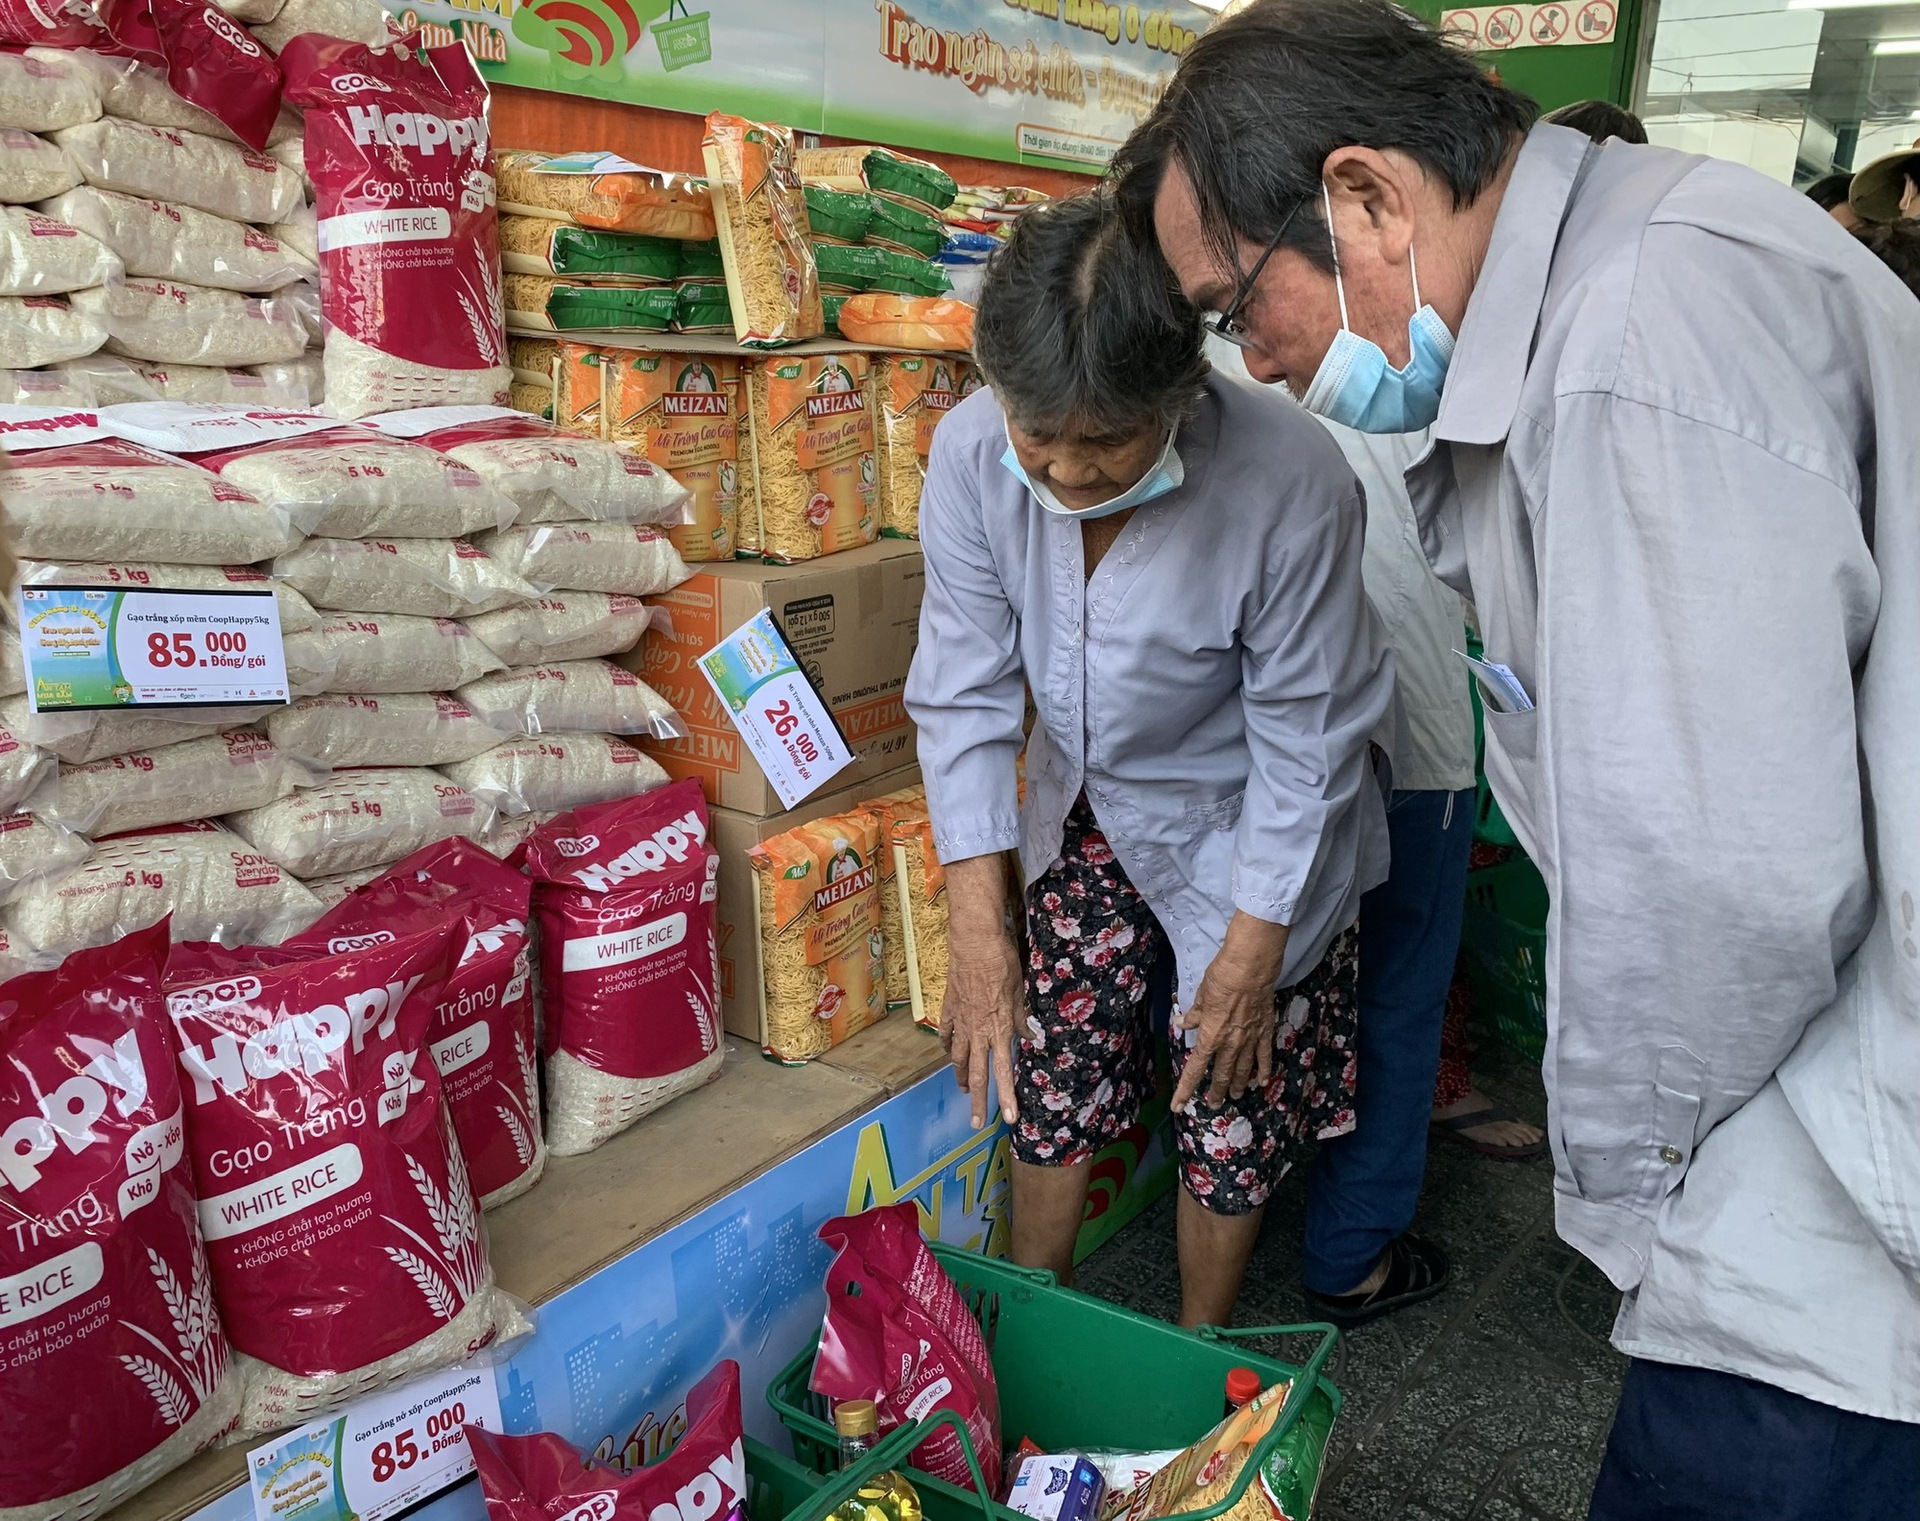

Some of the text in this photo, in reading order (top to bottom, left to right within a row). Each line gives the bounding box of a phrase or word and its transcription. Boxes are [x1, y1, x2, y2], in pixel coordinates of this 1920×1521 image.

[207, 14, 258, 53] COOP
[461, 19, 508, 62] Nhà
[876, 1, 938, 66] Trao
[335, 75, 386, 91] COOP
[346, 104, 488, 160] Happy
[406, 174, 454, 201] Trắng
[364, 217, 437, 235] WHITE RICE
[157, 283, 165, 294] 5
[171, 286, 186, 303] kg
[640, 359, 655, 371] Mới
[784, 366, 798, 378] Mới
[664, 396, 727, 413] MEIZAN
[808, 391, 864, 415] MEIZAN
[552, 452, 577, 467] 5 kg
[670, 447, 694, 456] PREMIUM
[350, 465, 384, 477] 5 kg
[364, 542, 396, 555] 5 kg
[108, 568, 150, 583] 5 kg
[541, 600, 565, 613] 5 kg
[819, 609, 831, 621] 500
[127, 613, 270, 626] Gạo trắng xốp mềm CoopHappy5kg
[347, 621, 378, 635] 5 kg
[788, 615, 799, 629] gói
[799, 615, 808, 625] 12
[205, 631, 247, 652] 000
[686, 632, 703, 646] SỢI
[147, 632, 207, 668] 85.
[644, 642, 681, 674] Cấp
[211, 654, 266, 669] Đồng/ gói
[539, 669, 565, 681] 5 kg
[831, 691, 852, 705] HẠNG
[852, 683, 879, 698] THƯỢNG
[348, 696, 378, 712] 5 kg
[764, 699, 799, 745] 26.
[229, 742, 274, 756] Everyday
[540, 744, 564, 759] 5 kg
[796, 733, 819, 762] 000
[814, 727, 827, 747] Meizan
[824, 745, 835, 761] 500gr
[113, 756, 154, 771] 5 kg
[798, 766, 812, 780] gói
[352, 800, 381, 816] 5 kg
[558, 835, 595, 854] COOP
[571, 810, 707, 892] Happy
[125, 871, 163, 888] 5 kg
[236, 866, 280, 879] Everyday
[791, 865, 808, 879] Mới
[816, 868, 875, 909] MEIZAN
[598, 881, 695, 924] Gạo Trắng
[332, 933, 390, 954] COOP
[597, 926, 673, 959] WHITE RICE
[604, 949, 687, 983] KHÔNG chất tạo hương
[605, 960, 686, 995] KHÔNG chất bảo quản
[174, 977, 256, 1012] COOP
[508, 981, 523, 996] Khô
[435, 981, 497, 1026] Trắng
[179, 974, 426, 1106] Happy
[440, 1036, 474, 1066] RICE
[0, 1028, 147, 1194] ppy
[384, 1096, 402, 1112] Khô
[131, 1124, 182, 1165] Nở Xốp
[209, 1097, 367, 1178] Gạo Trắng
[126, 1180, 154, 1201] Khô
[220, 1163, 338, 1225] WHITE RICE
[7, 1189, 104, 1253] Trắng
[241, 1190, 372, 1255] KHÔNG chất tạo hương
[245, 1205, 373, 1271] KHÔNG chất bảo quản
[20, 1265, 75, 1307] RICE
[8, 1294, 112, 1352] chất tạo hương
[11, 1312, 110, 1369] chất bảo quản
[896, 1362, 945, 1406] Gạo Trắng
[263, 1401, 284, 1414] XỐP
[355, 1375, 482, 1444] Gạo trắng nở xốp CoopHappy5kg
[911, 1384, 945, 1418] WHITE RICE
[426, 1402, 466, 1438] 000
[371, 1428, 431, 1483] 85.
